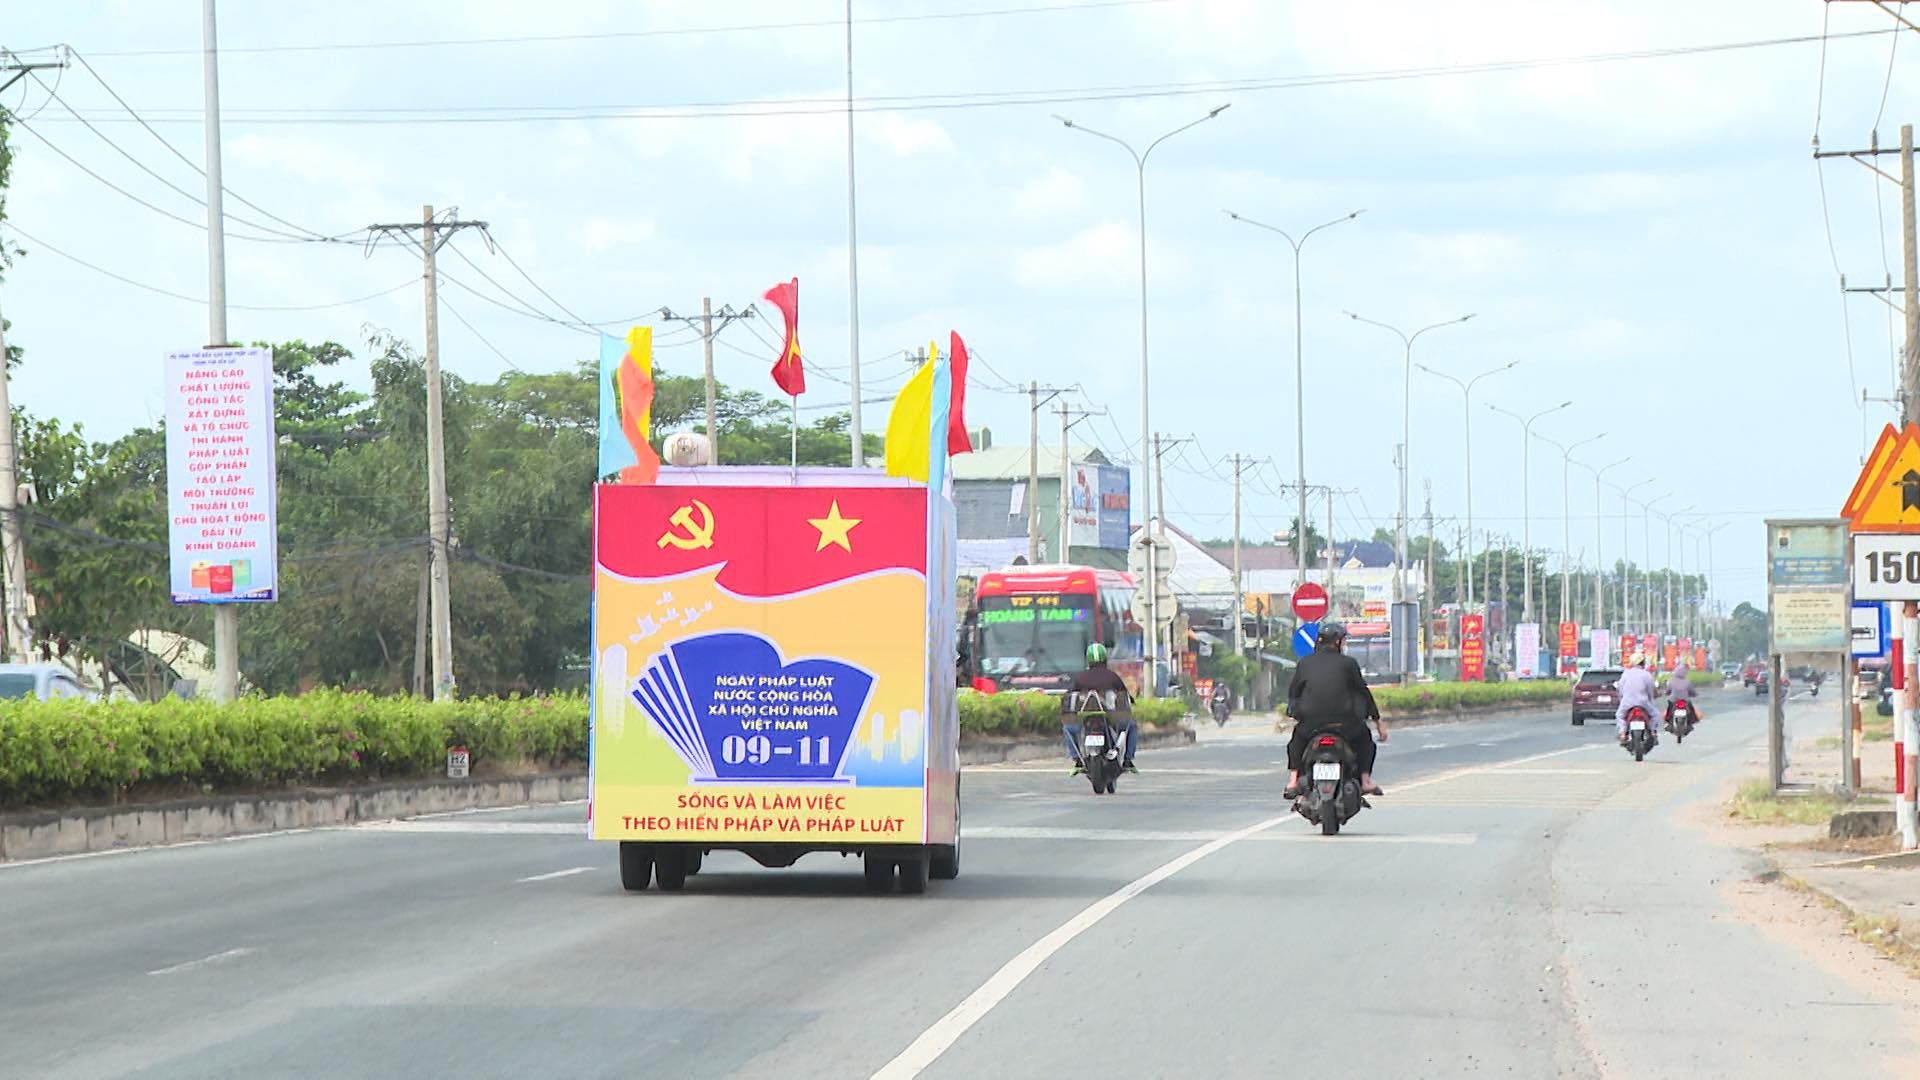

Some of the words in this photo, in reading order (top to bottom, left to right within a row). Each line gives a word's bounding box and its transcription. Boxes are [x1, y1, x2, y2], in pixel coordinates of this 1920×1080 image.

[222, 369, 244, 378] CAO
[192, 437, 208, 445] THI
[174, 516, 197, 525] CHO
[185, 543, 213, 551] KINH
[216, 541, 256, 550] DOANH
[1865, 550, 1920, 585] 150
[716, 674, 755, 687] NGÀY
[758, 674, 797, 687] PHÁP
[800, 674, 835, 690] LUẬT
[713, 688, 756, 701] NƯỚC
[758, 690, 799, 704] CỘNG
[802, 689, 833, 702] HÒA
[708, 704, 728, 716] XÃ
[730, 704, 756, 718] HỘI
[759, 703, 790, 716] CHỦ
[793, 703, 839, 716] NGHĨA
[741, 717, 772, 732] VIỆT
[775, 719, 809, 731] NAM
[677, 790, 730, 810] SỐNG
[733, 790, 757, 810] VÀ
[762, 790, 802, 811] LÀM
[806, 792, 847, 814] VIỆC
[622, 815, 672, 831] THEO
[676, 811, 719, 831] HIẾN
[724, 814, 774, 832] PHÁP
[778, 814, 802, 832] VÀ
[806, 814, 856, 832] PHÁP
[860, 815, 905, 836] LUẬT
